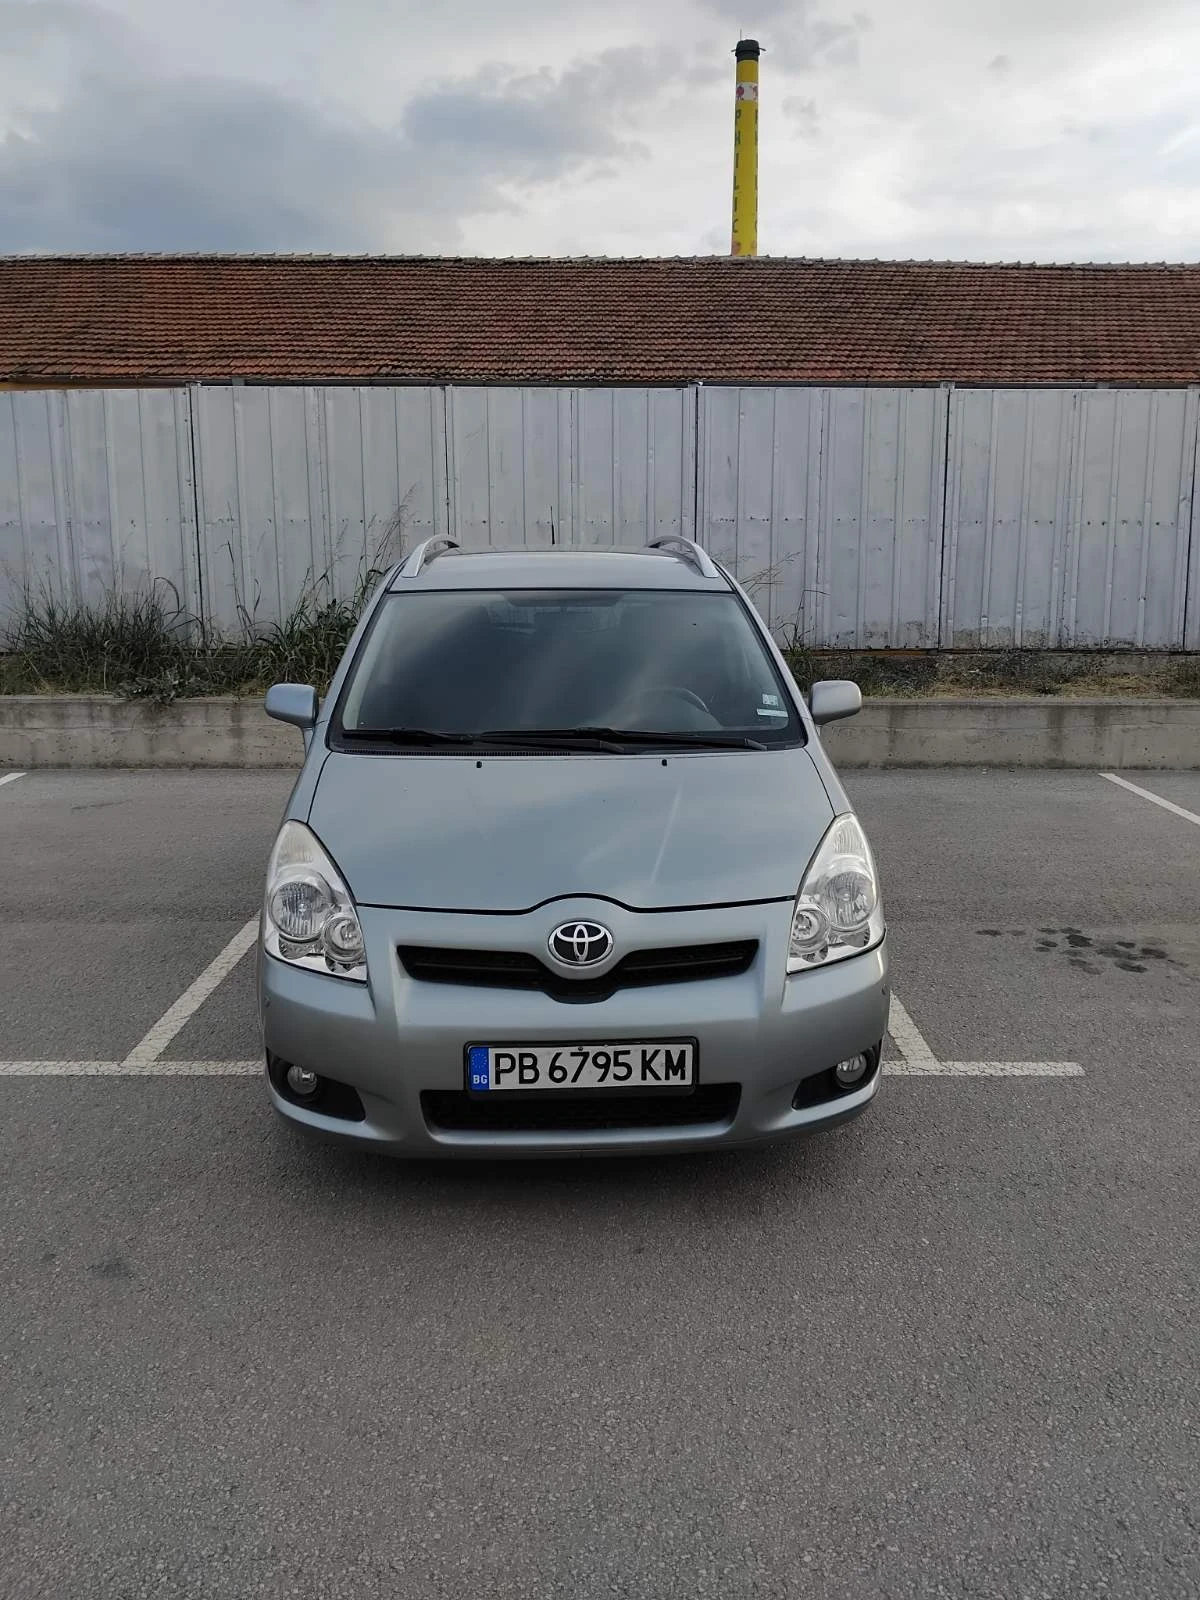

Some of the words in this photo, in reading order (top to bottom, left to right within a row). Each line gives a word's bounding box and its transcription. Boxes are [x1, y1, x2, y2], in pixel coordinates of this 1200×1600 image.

[494, 1052, 540, 1085] PB
[548, 1049, 633, 1084] 6795
[641, 1048, 687, 1081] KM
[472, 1074, 488, 1085] BG
